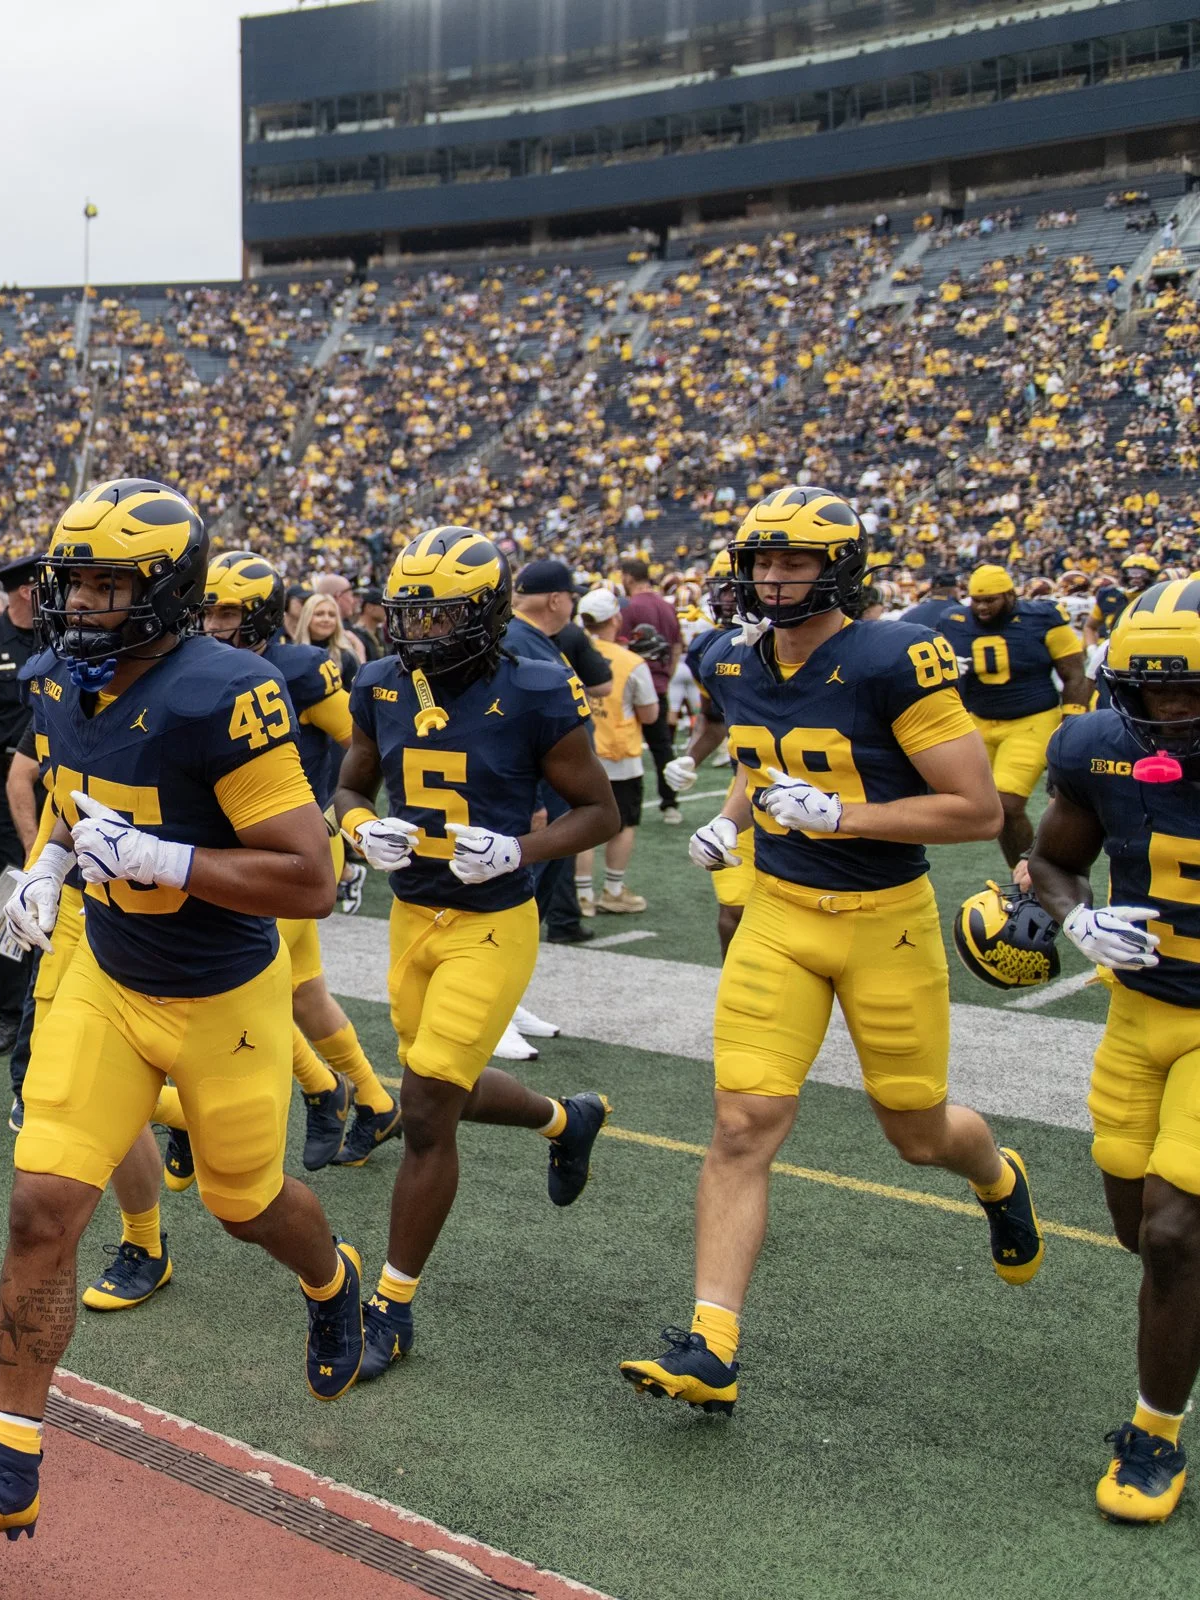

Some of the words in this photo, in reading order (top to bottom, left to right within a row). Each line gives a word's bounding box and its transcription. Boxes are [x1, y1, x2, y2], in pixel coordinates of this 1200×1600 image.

[63, 546, 75, 557] M
[408, 585, 419, 595] M
[907, 635, 959, 688] 89
[972, 635, 1011, 685] 0
[1147, 660, 1162, 670] M
[319, 659, 342, 695] 15
[566, 675, 591, 717] 5
[228, 679, 291, 750] 45
[403, 747, 470, 860] 5
[1002, 1248, 1017, 1257] M
[101, 1281, 115, 1291] M
[368, 1294, 389, 1313] M
[320, 1365, 332, 1376] M
